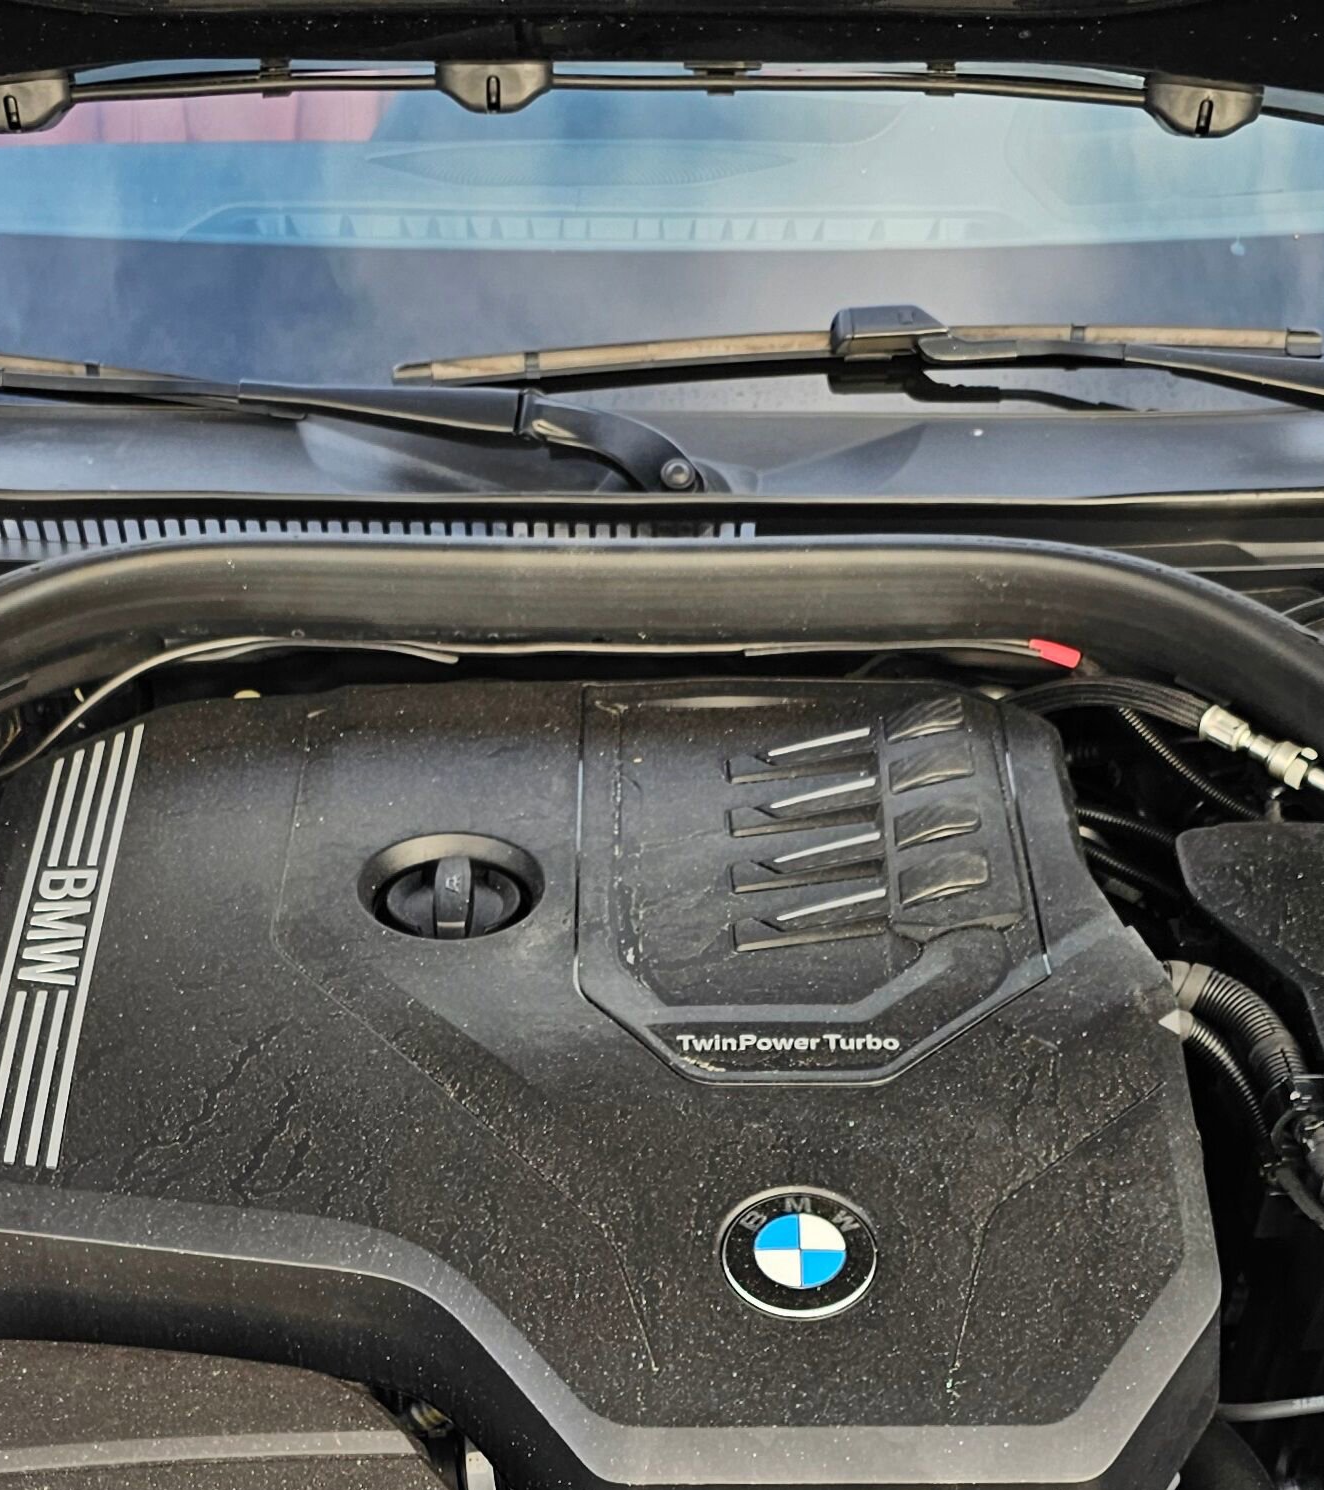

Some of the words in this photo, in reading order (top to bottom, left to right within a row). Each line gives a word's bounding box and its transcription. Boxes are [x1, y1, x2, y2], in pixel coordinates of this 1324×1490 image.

[17, 869, 99, 987] BMW
[676, 1033, 821, 1052] TwinPower
[822, 1033, 901, 1052] Turbo
[738, 1196, 862, 1235] BMW
